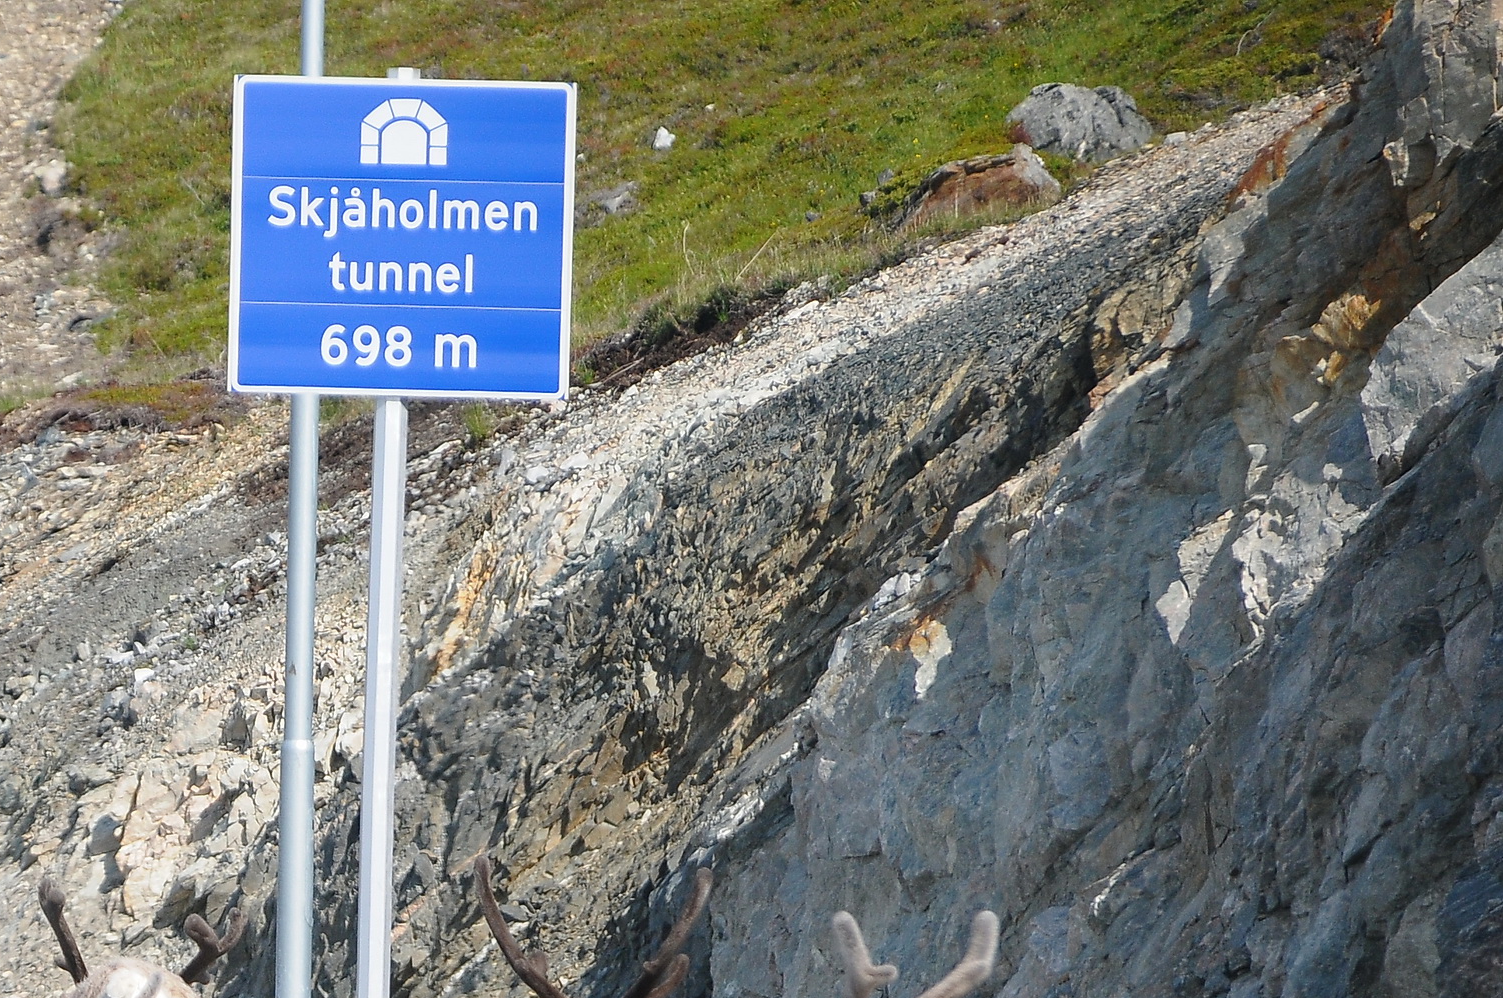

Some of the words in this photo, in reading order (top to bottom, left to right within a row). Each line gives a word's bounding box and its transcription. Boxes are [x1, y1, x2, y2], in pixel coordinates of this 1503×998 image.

[267, 184, 538, 239] Skjåholmen
[328, 251, 474, 293] tunnel
[320, 323, 413, 367] 698
[434, 331, 478, 369] m
